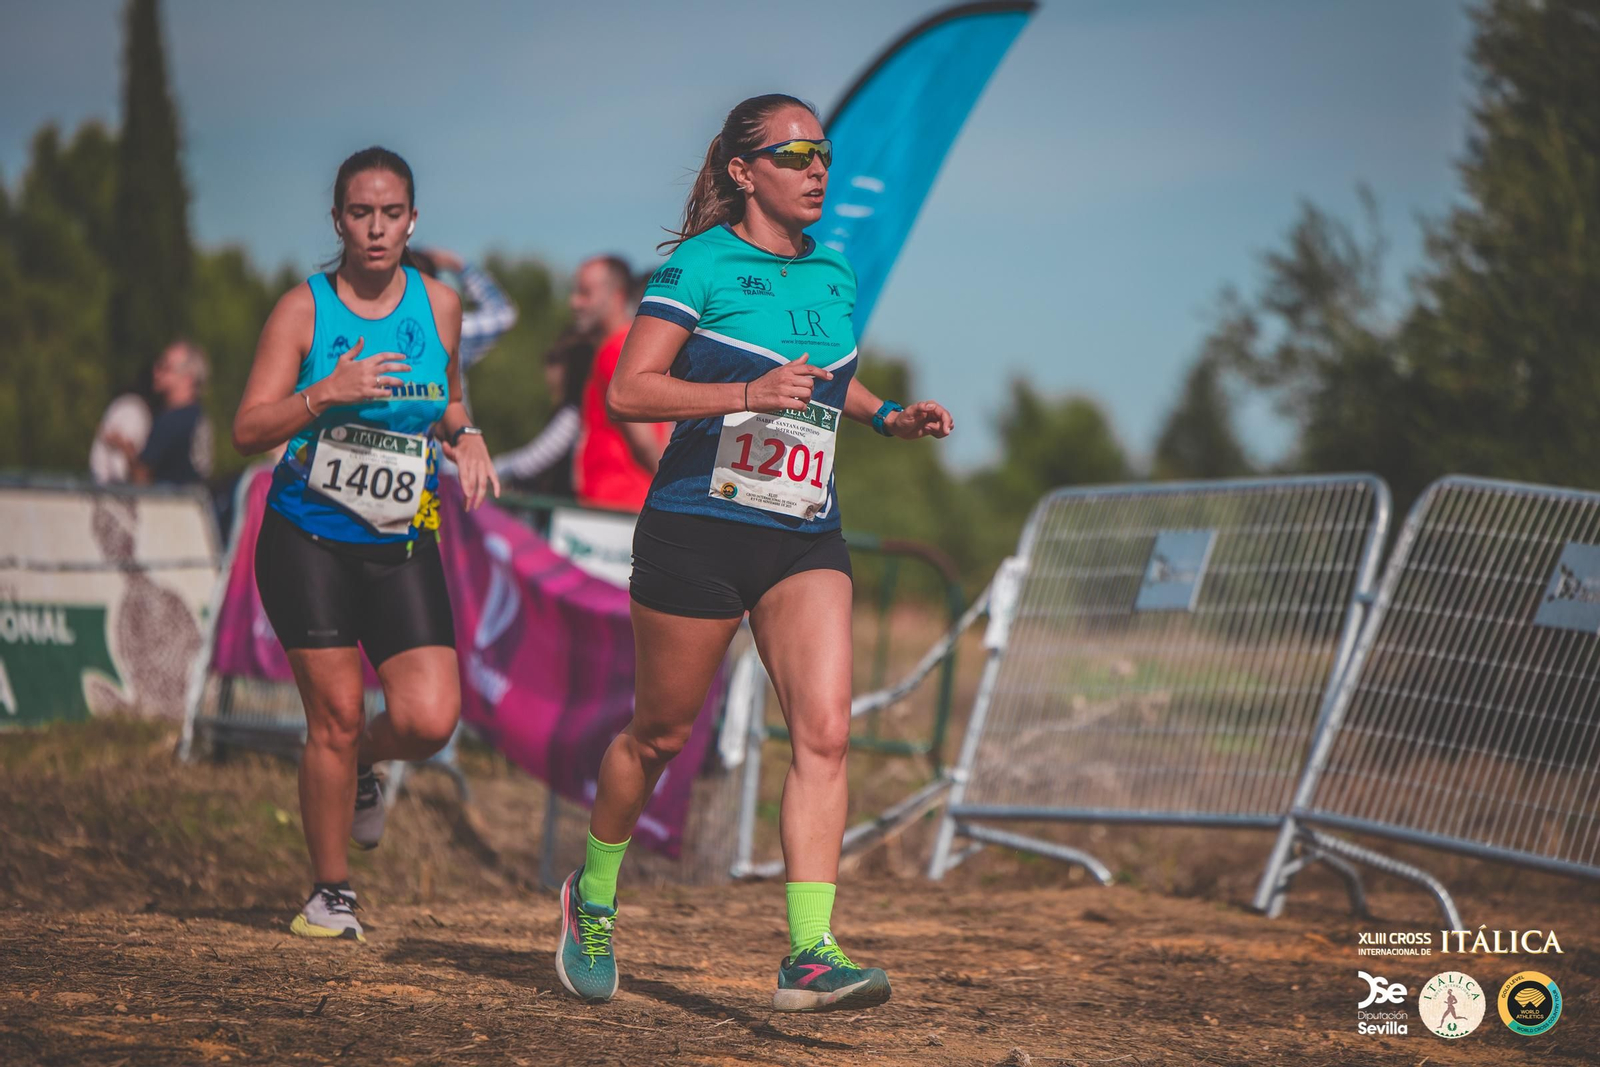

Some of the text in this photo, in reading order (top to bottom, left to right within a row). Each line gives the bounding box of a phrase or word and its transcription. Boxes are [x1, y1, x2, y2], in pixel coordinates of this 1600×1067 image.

[785, 309, 830, 339] LR
[756, 417, 774, 426] ISABEL
[776, 420, 800, 430] SANTANA
[731, 433, 824, 489] 1201
[322, 459, 417, 504] 1408
